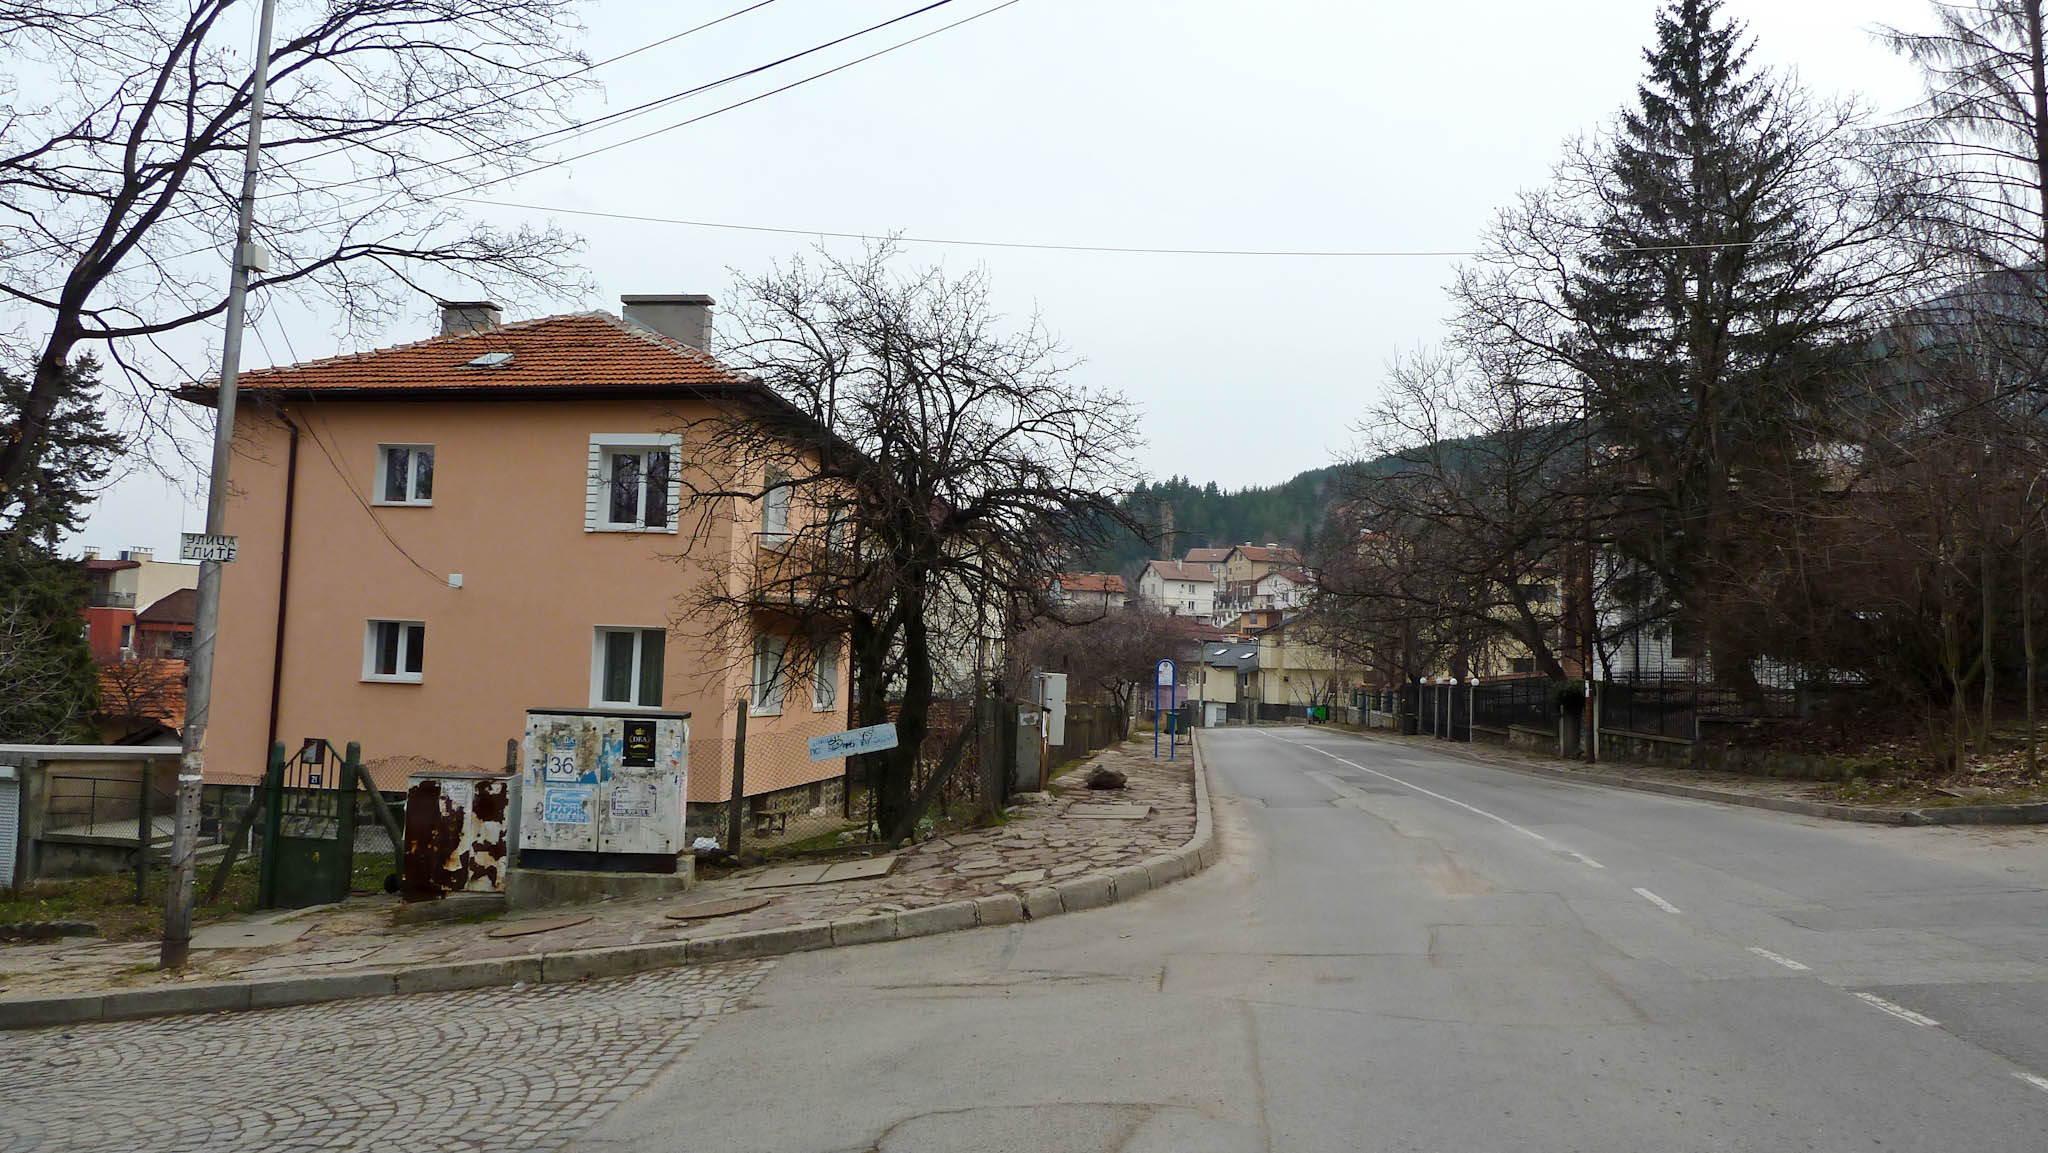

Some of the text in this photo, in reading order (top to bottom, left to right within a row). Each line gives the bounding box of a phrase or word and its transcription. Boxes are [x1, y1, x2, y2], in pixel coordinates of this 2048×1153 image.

[186, 535, 235, 547] УЛИЦА
[183, 546, 237, 560] ЕЛИТЕ
[550, 756, 574, 775] 36
